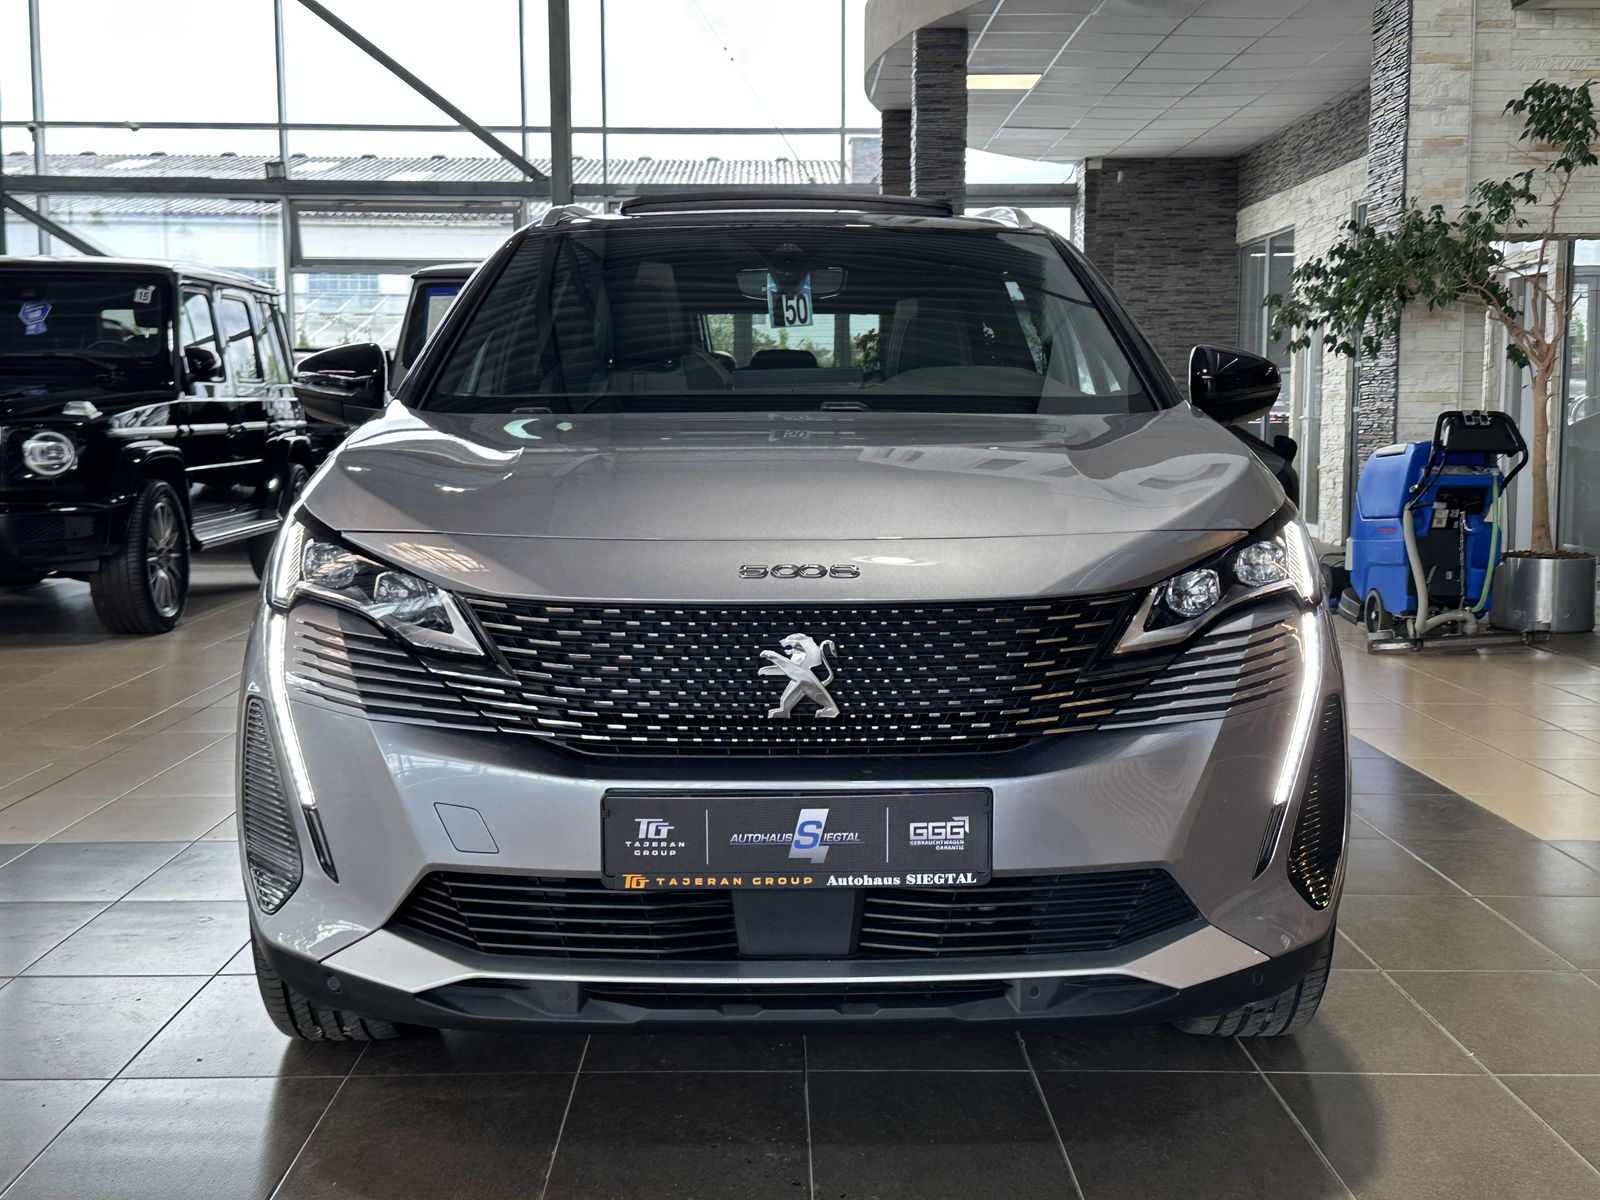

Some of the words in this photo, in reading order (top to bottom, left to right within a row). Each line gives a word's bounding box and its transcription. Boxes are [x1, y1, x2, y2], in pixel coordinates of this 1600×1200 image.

[785, 294, 808, 325] 50
[738, 564, 861, 579] 5008
[909, 821, 965, 840] GGG
[729, 833, 793, 843] AUTOHAUS
[656, 877, 742, 886] TAJERAN
[752, 876, 813, 886] GROUP
[826, 875, 901, 886] Autohaus
[906, 872, 977, 885] SIEGTAL
